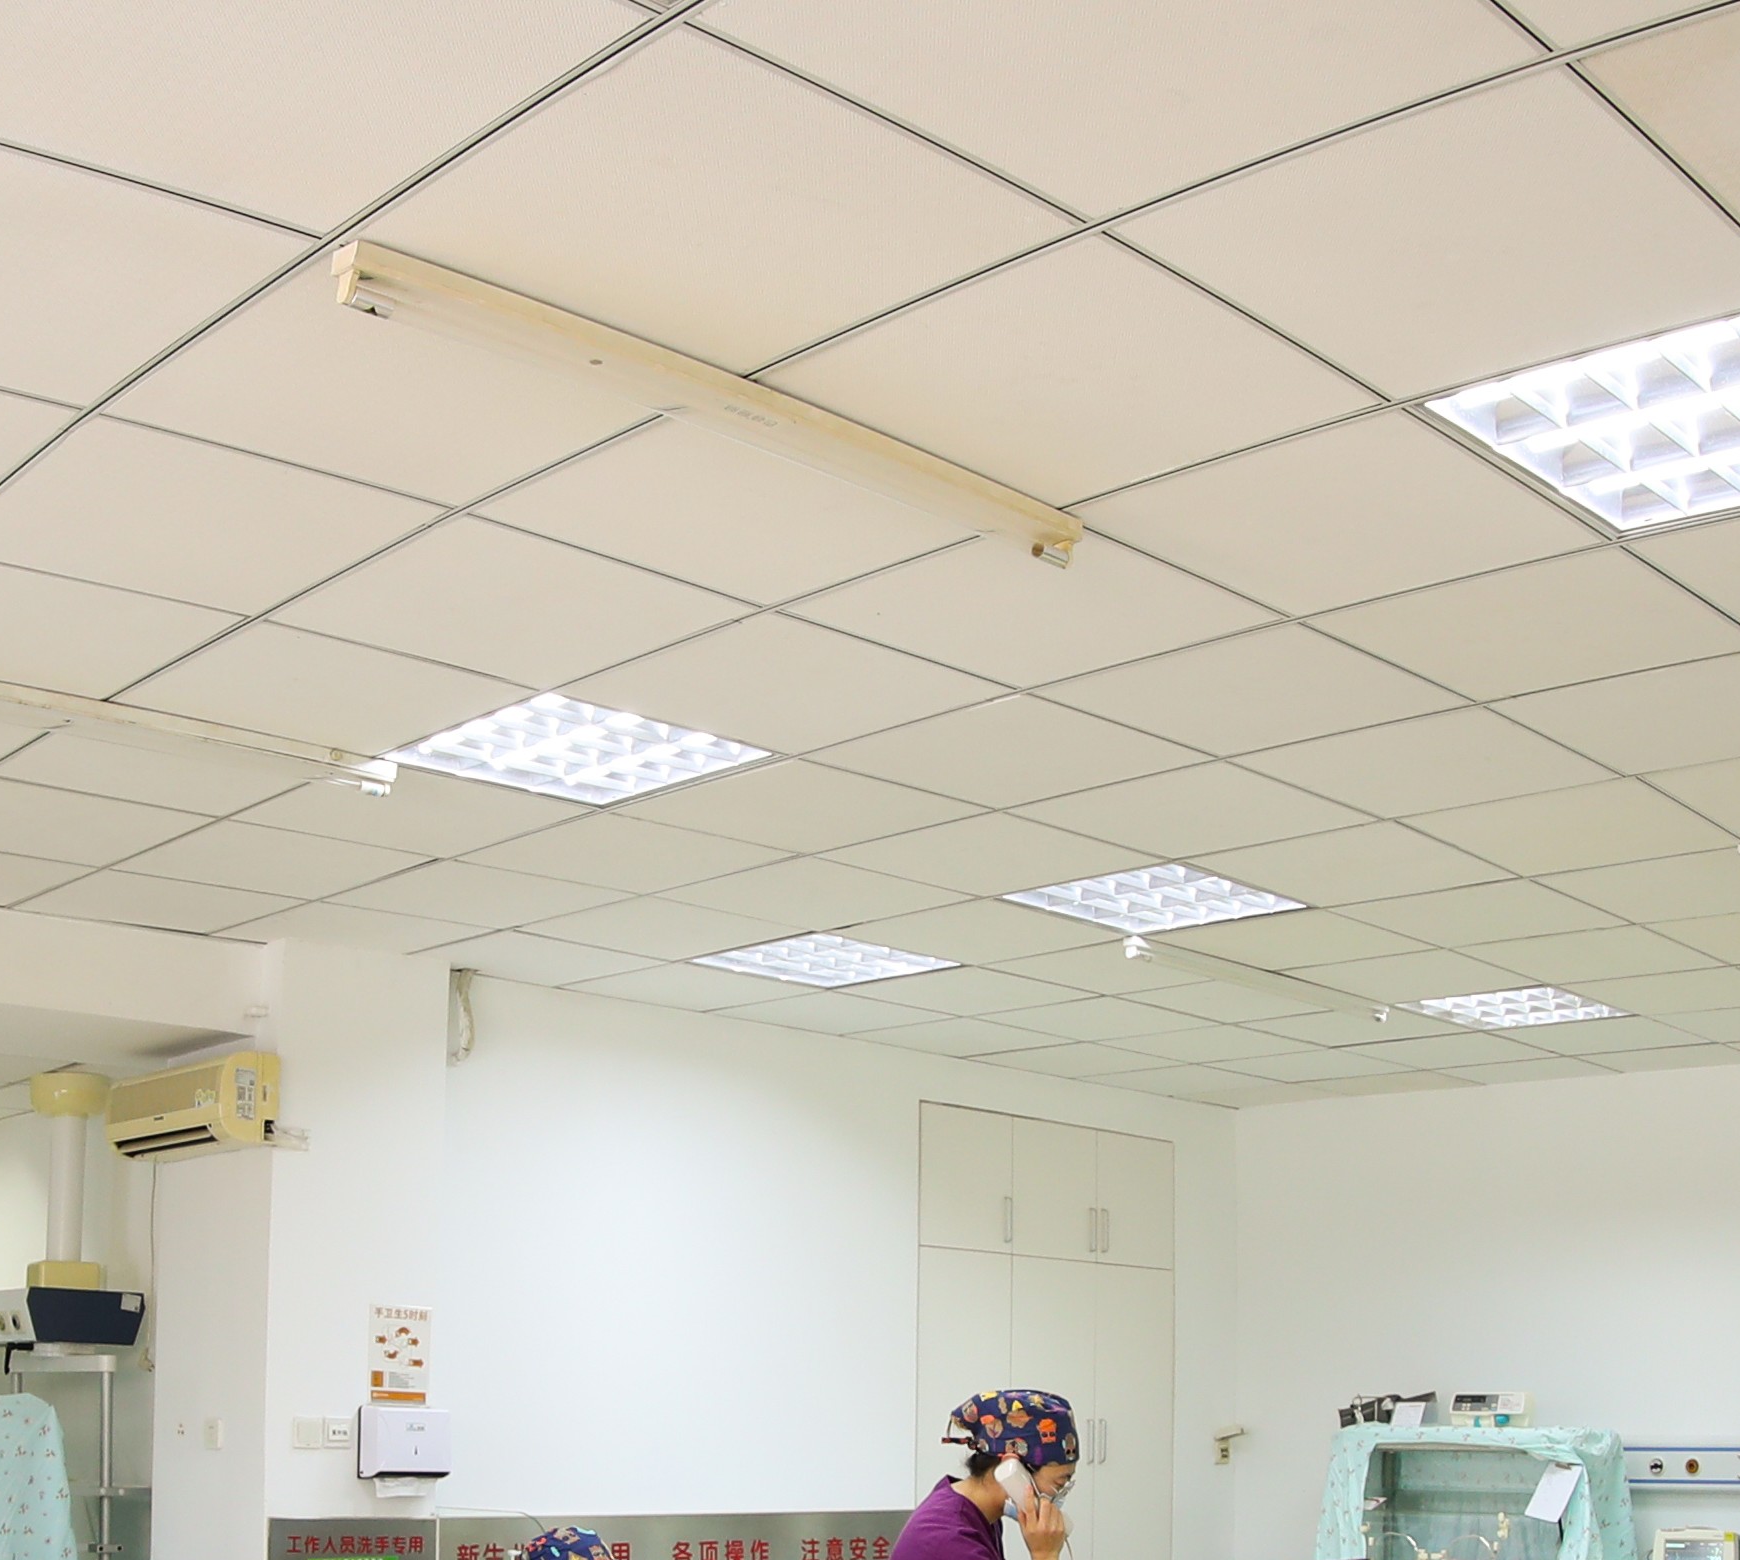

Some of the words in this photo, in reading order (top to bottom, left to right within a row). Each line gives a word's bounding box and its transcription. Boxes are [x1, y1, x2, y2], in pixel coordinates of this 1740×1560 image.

[374, 1306, 429, 1322] 手卫生5时刻
[286, 1535, 425, 1554] 工作人员洗手专用
